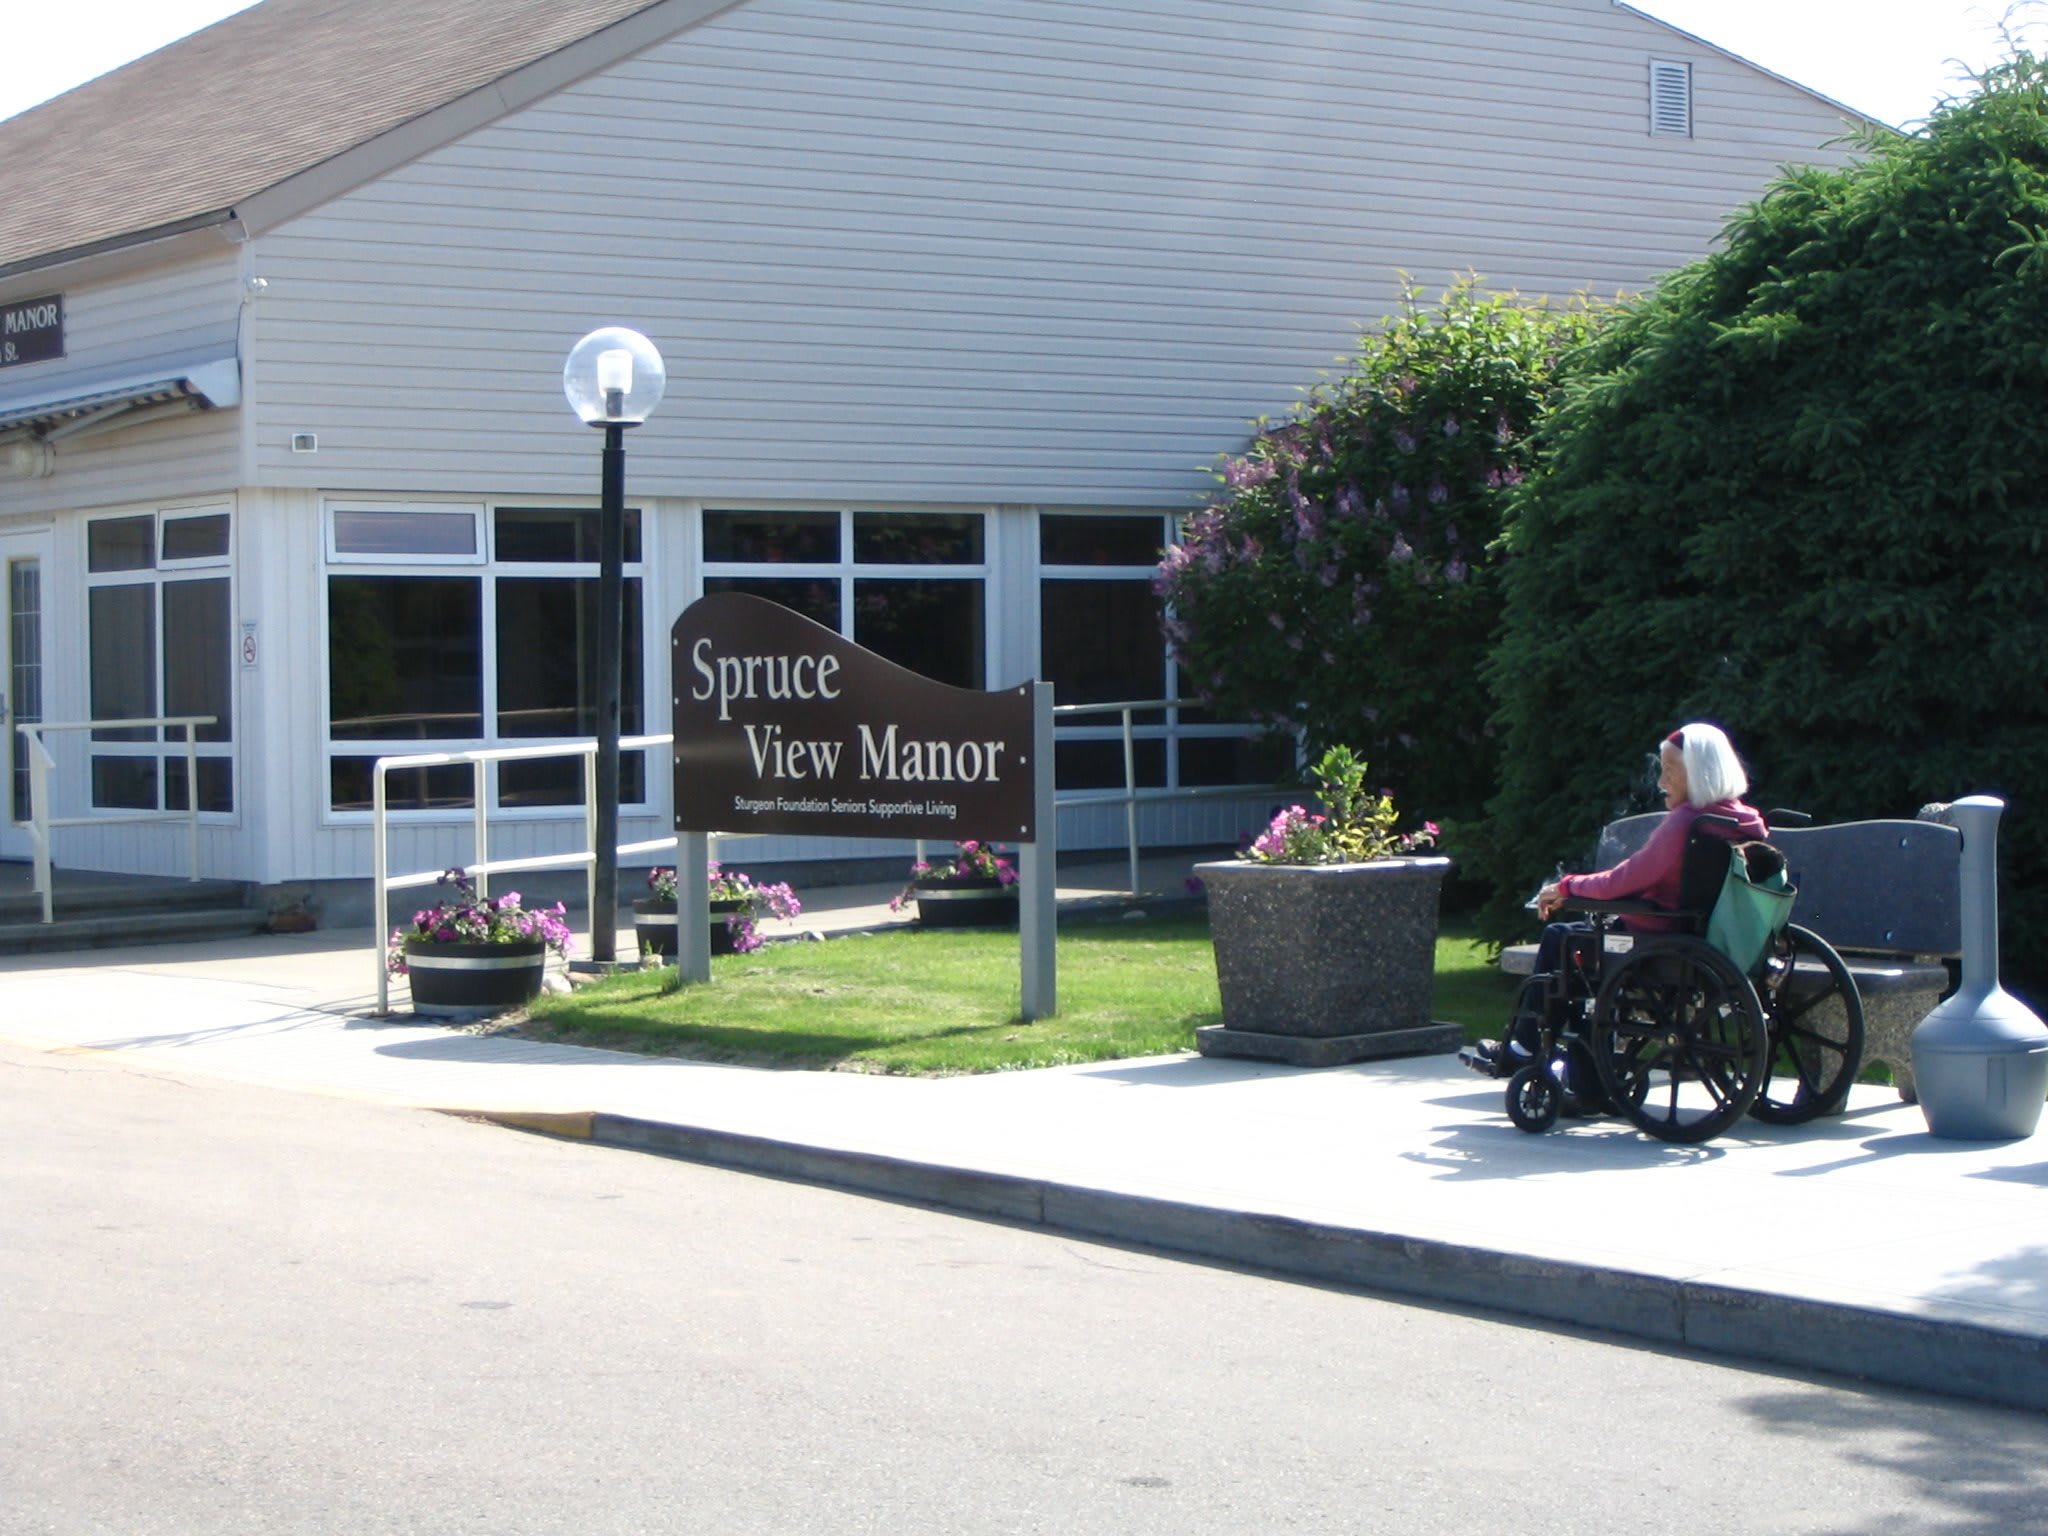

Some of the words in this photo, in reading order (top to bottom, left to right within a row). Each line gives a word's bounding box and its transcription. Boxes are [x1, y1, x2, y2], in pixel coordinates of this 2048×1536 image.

[5, 303, 58, 335] MANOR
[692, 638, 841, 721] Spruce
[743, 724, 843, 779] View
[857, 723, 1005, 782] Manor
[734, 795, 776, 814] Sturgeon
[776, 796, 830, 812] Foundation
[831, 798, 867, 813] Seniors
[868, 799, 924, 818] Supportive
[926, 800, 957, 819] Living
